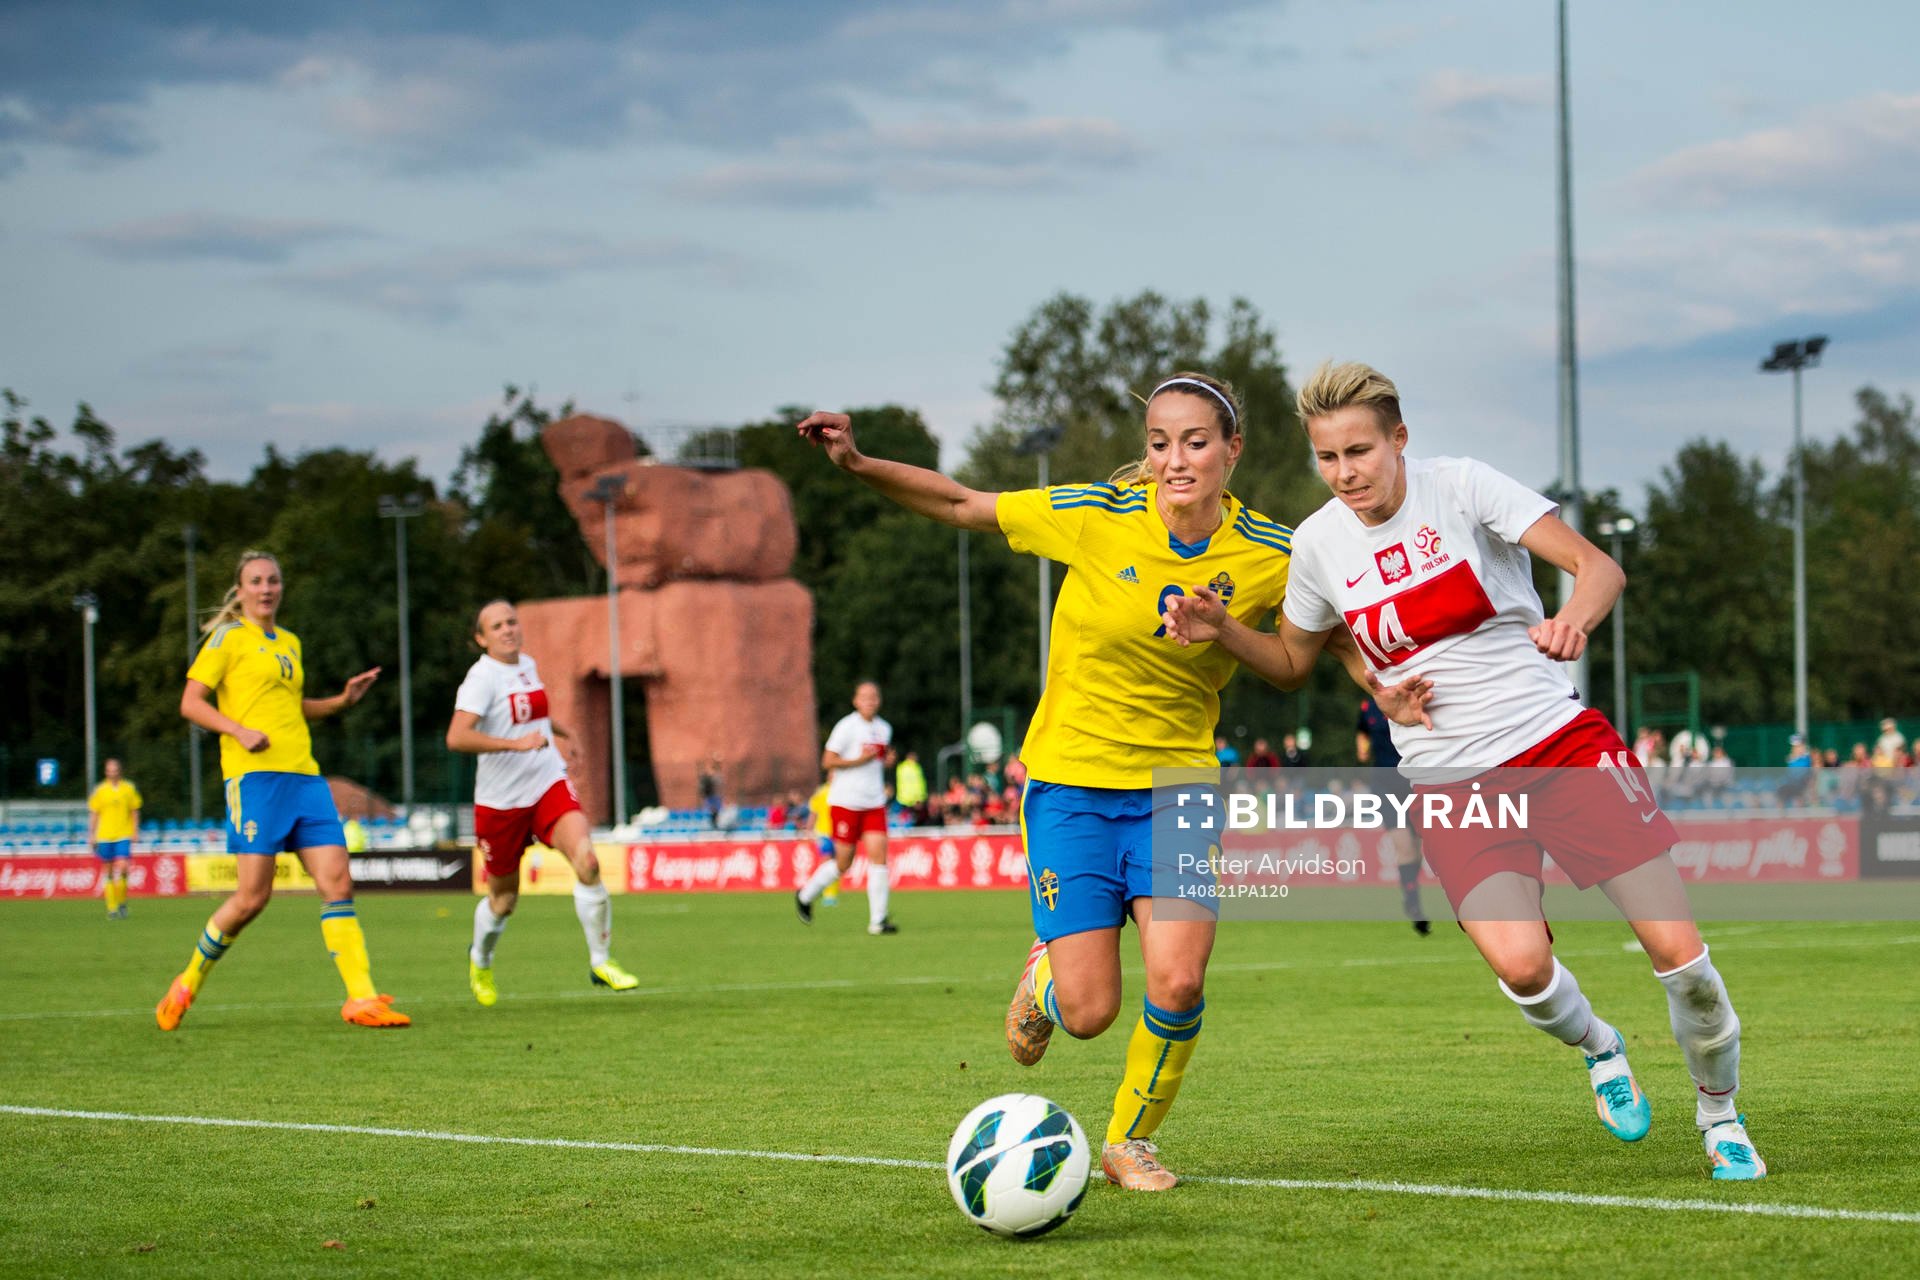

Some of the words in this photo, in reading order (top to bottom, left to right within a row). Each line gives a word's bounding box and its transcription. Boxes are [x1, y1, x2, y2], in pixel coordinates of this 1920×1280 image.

[1421, 553, 1450, 573] POLSKA
[1352, 601, 1419, 664] 14
[514, 692, 532, 723] 6
[1597, 751, 1652, 804] 14
